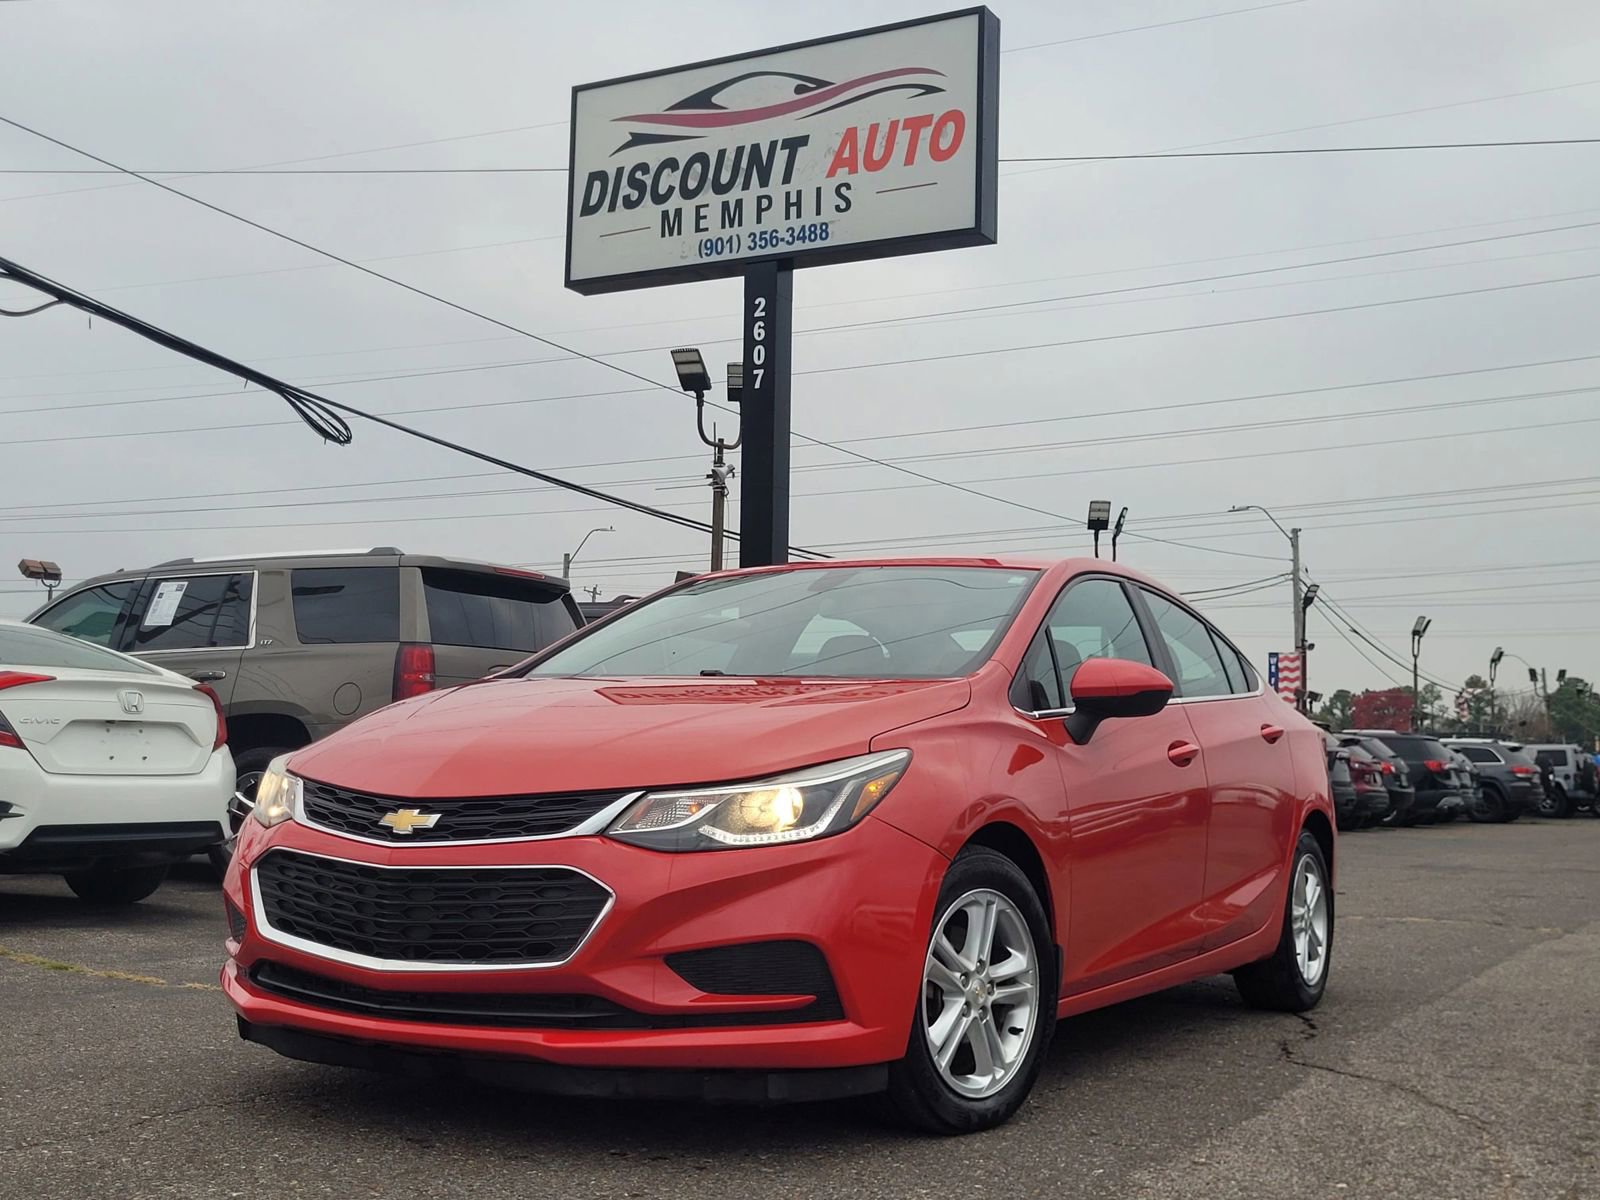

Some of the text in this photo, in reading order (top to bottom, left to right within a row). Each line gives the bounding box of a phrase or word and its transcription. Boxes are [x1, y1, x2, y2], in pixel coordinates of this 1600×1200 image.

[579, 109, 966, 217] DISCOUNT AUTO
[660, 182, 853, 238] MEMPHIS
[698, 222, 831, 258] (901) 356-3488
[753, 297, 766, 389] 2607
